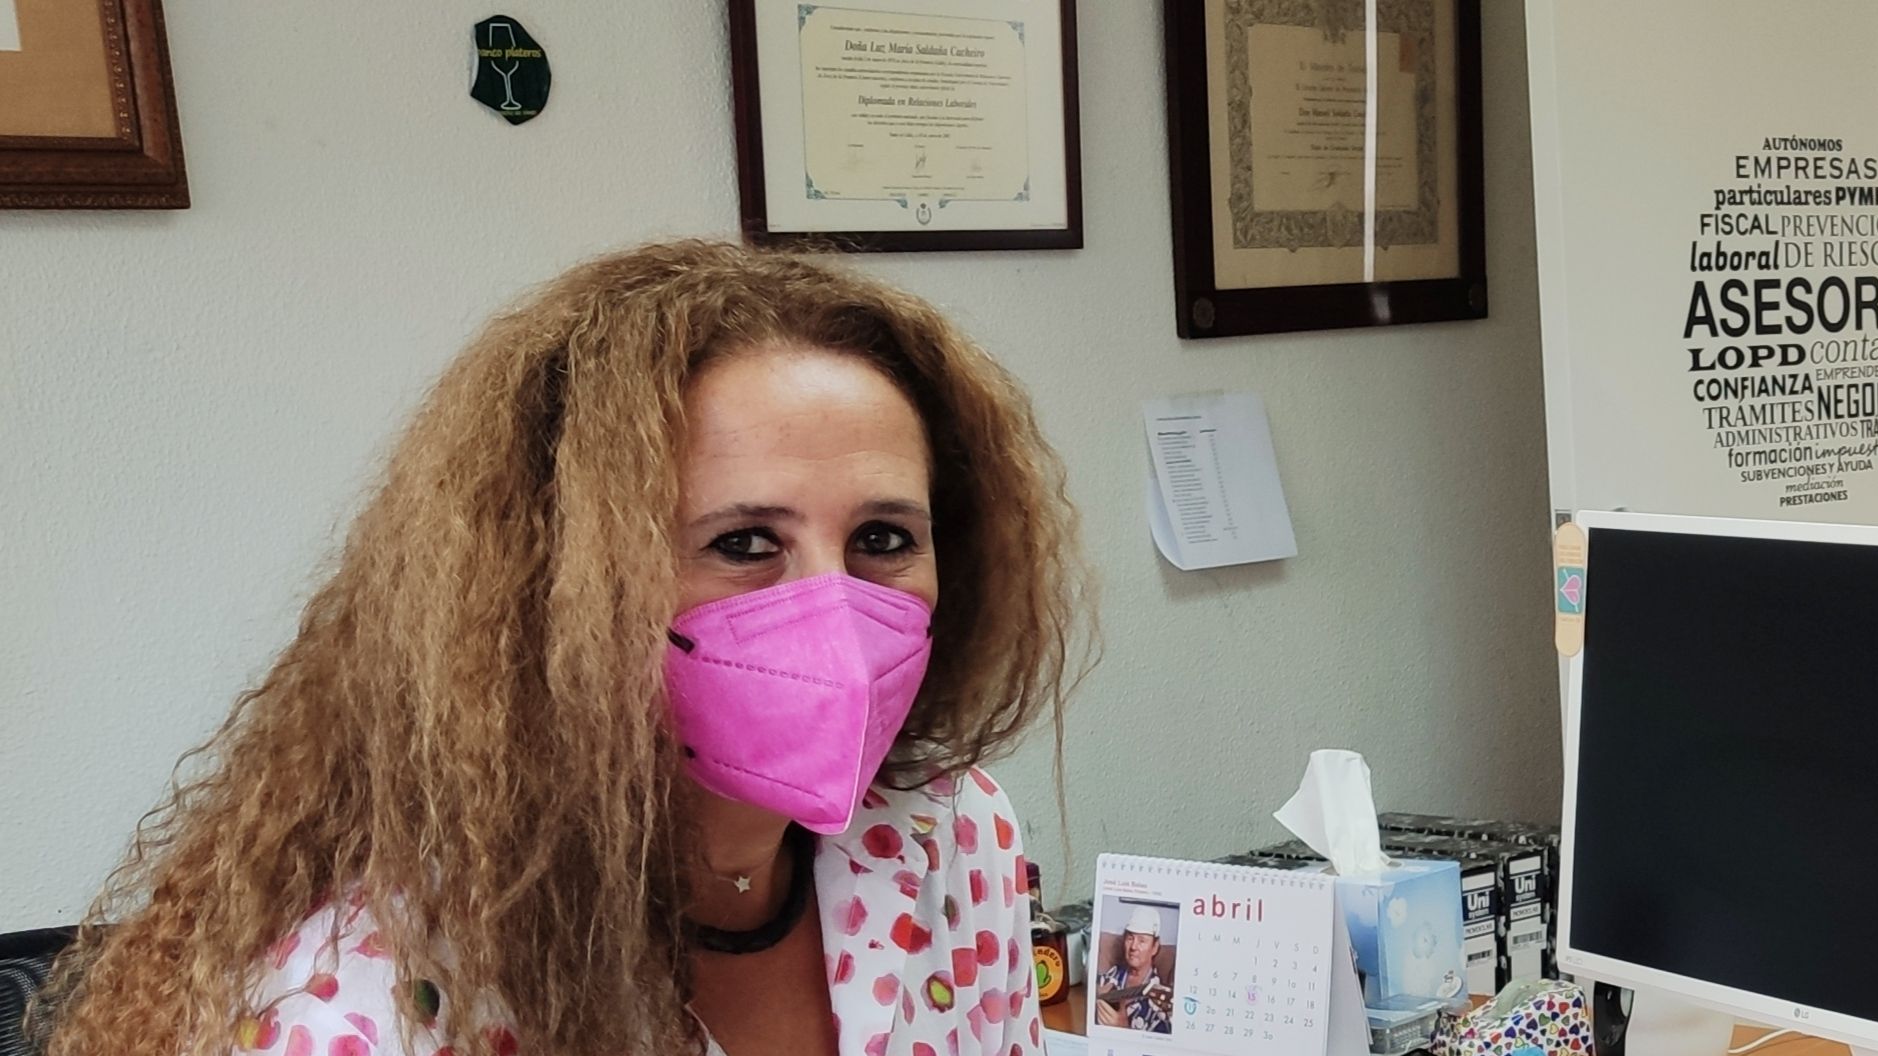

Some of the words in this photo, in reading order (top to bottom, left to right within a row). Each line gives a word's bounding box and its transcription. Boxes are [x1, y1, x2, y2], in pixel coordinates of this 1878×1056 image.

[1763, 135, 1843, 152] AUTÓNOMOS
[1735, 156, 1877, 180] EMPRESAS
[1714, 184, 1832, 210] particulares
[1700, 213, 1778, 236] FISCAL
[1690, 240, 1780, 272] laboral
[1784, 242, 1814, 269] DE
[1687, 344, 1806, 372] LOPD
[1693, 373, 1813, 402] CONFIANZA
[1703, 397, 1814, 430] TRÁMITES
[1714, 421, 1858, 448] ADMINISTRATIVOS
[1728, 443, 1813, 468] formación
[1741, 464, 1827, 482] SUBVENCIONES
[1828, 462, 1835, 474] Y
[1837, 459, 1873, 474] AYUDA
[1786, 477, 1844, 493] mediación
[1780, 490, 1848, 507] PRESTACIONES
[1514, 874, 1536, 893] Uni
[1193, 894, 1263, 922] abril
[1467, 891, 1490, 911] Uni
[1273, 960, 1278, 968] 2
[1292, 962, 1297, 970] 3
[1312, 965, 1317, 973] 4
[1194, 968, 1198, 976] 5
[1213, 971, 1218, 979] 6
[1252, 975, 1257, 984] 8
[1272, 977, 1276, 986] 9
[1309, 982, 1315, 991] 11
[1189, 986, 1198, 994] 12
[1209, 988, 1216, 996] 13
[1228, 990, 1236, 999] 14
[1248, 993, 1255, 1001] 15
[1267, 995, 1275, 1003] 16
[1287, 998, 1295, 1006] 17
[1307, 1001, 1314, 1009] 18
[1186, 1021, 1195, 1030] 26
[1205, 1024, 1215, 1032] 27
[1224, 1026, 1234, 1035] 28
[1244, 1029, 1253, 1037] 29
[1226, 1008, 1234, 1017] 21
[1245, 1011, 1254, 1019] 22
[1264, 1013, 1274, 1022] 23
[1284, 1016, 1294, 1024] 24
[1304, 1018, 1313, 1027] 25
